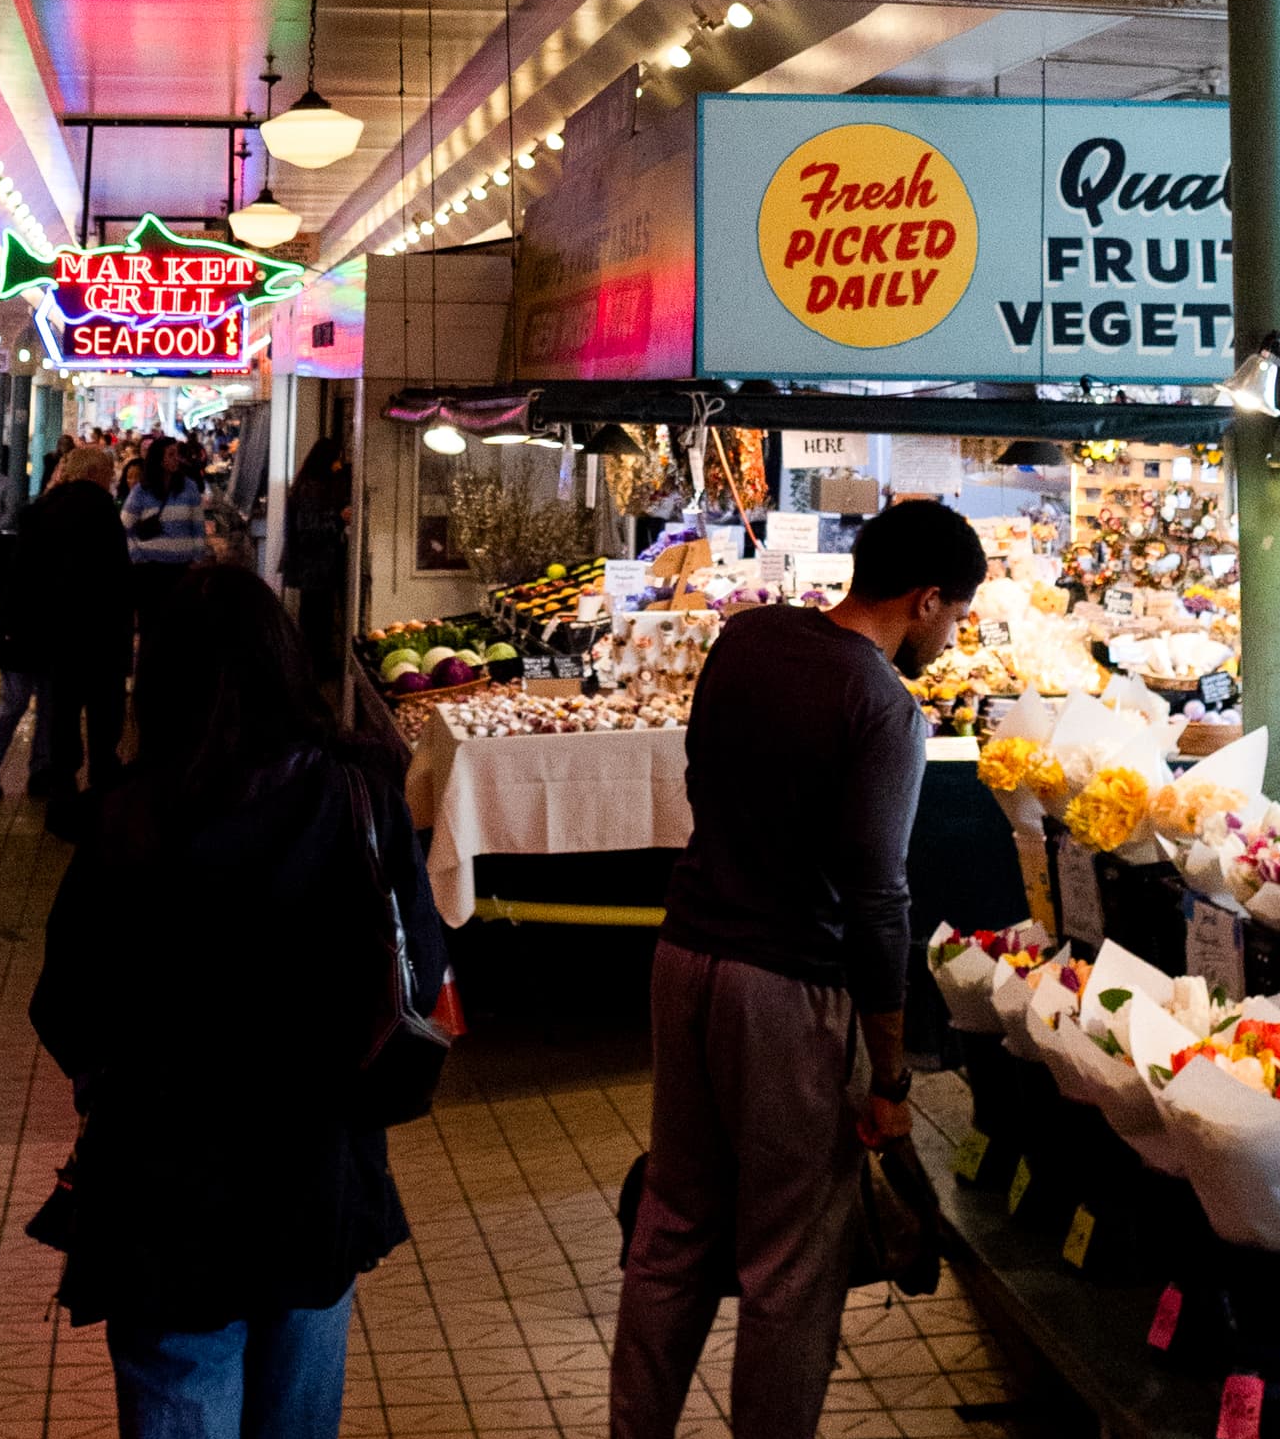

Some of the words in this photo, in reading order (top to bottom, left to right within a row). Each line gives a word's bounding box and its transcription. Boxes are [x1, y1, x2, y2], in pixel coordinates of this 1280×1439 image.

[800, 151, 938, 220] Fresh
[783, 219, 958, 270] PICKED
[55, 253, 254, 286] MARKET
[84, 283, 226, 316] GRILL
[806, 268, 940, 316] DAILY
[73, 326, 216, 356] SEAFOOD
[803, 437, 846, 455] HERE
